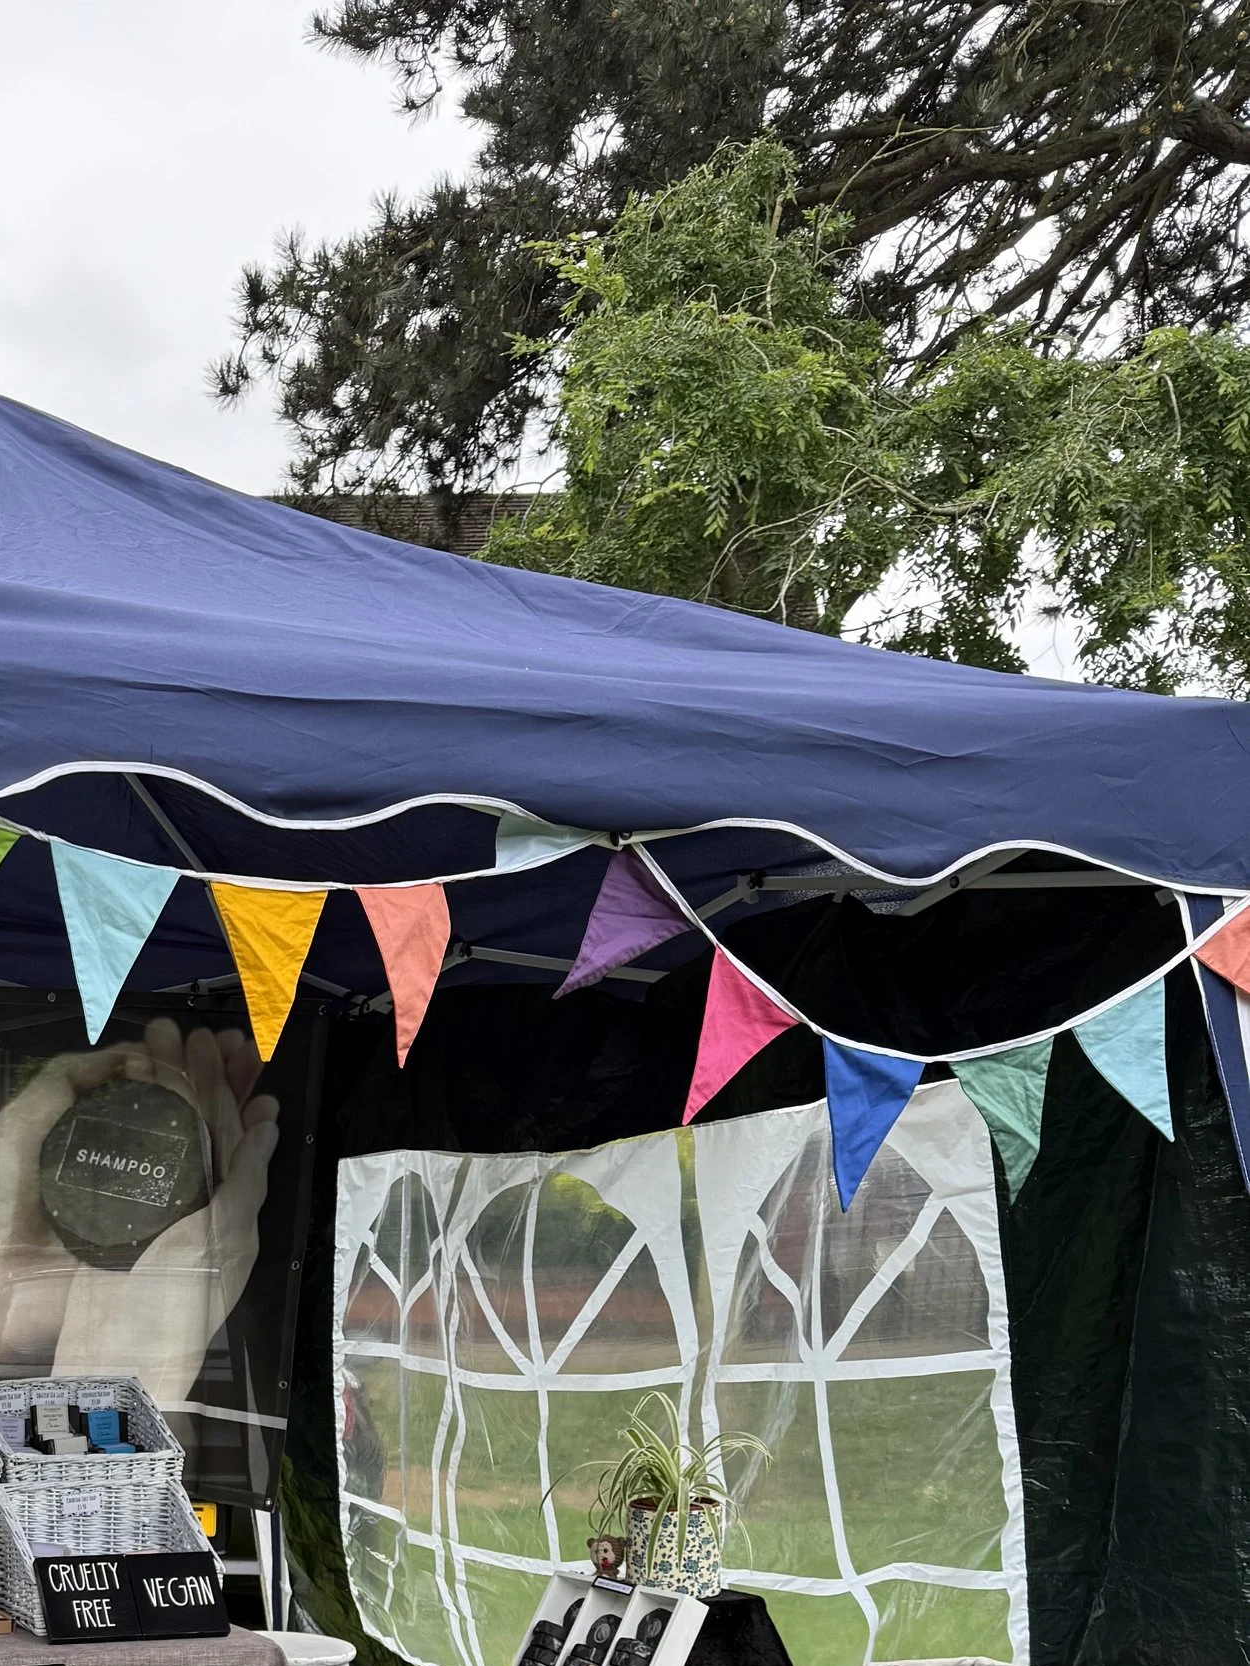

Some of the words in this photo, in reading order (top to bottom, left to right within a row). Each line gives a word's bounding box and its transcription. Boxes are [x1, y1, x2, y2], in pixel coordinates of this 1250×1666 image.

[75, 1149, 166, 1179] SHAMPOO
[48, 1561, 120, 1593] CRUELTY
[143, 1575, 216, 1608] VEGAN
[72, 1598, 117, 1629] FREE
